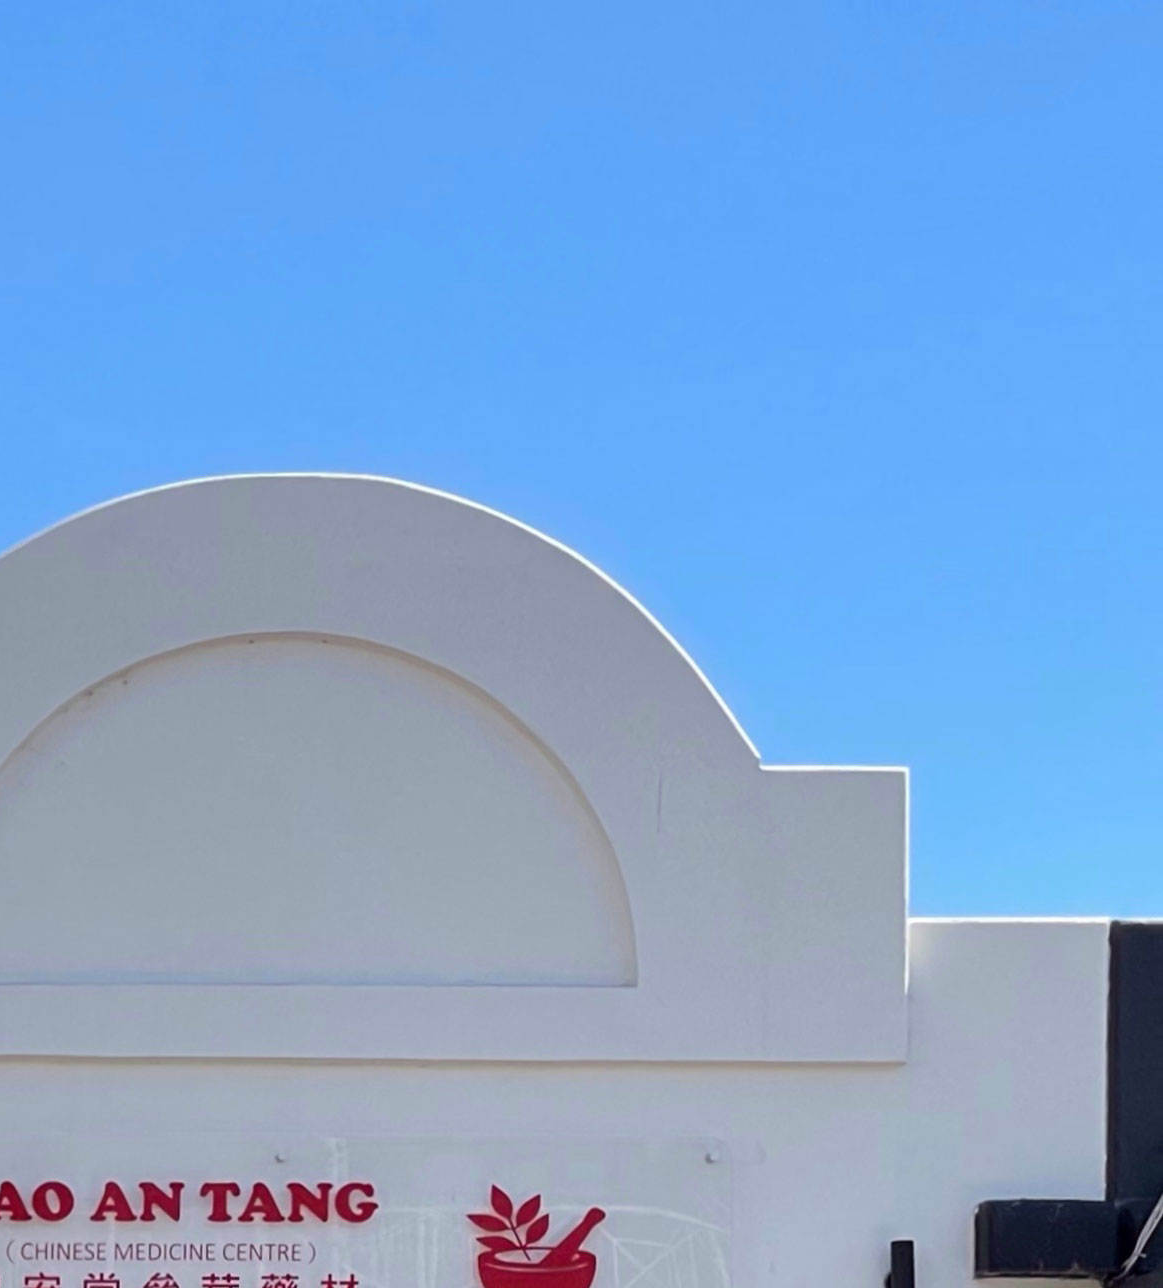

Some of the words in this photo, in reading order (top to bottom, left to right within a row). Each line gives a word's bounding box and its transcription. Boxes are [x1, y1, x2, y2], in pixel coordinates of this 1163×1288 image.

[89, 1182, 185, 1222] AN
[200, 1182, 379, 1222] TANG
[114, 1243, 216, 1263] MEDICINE
